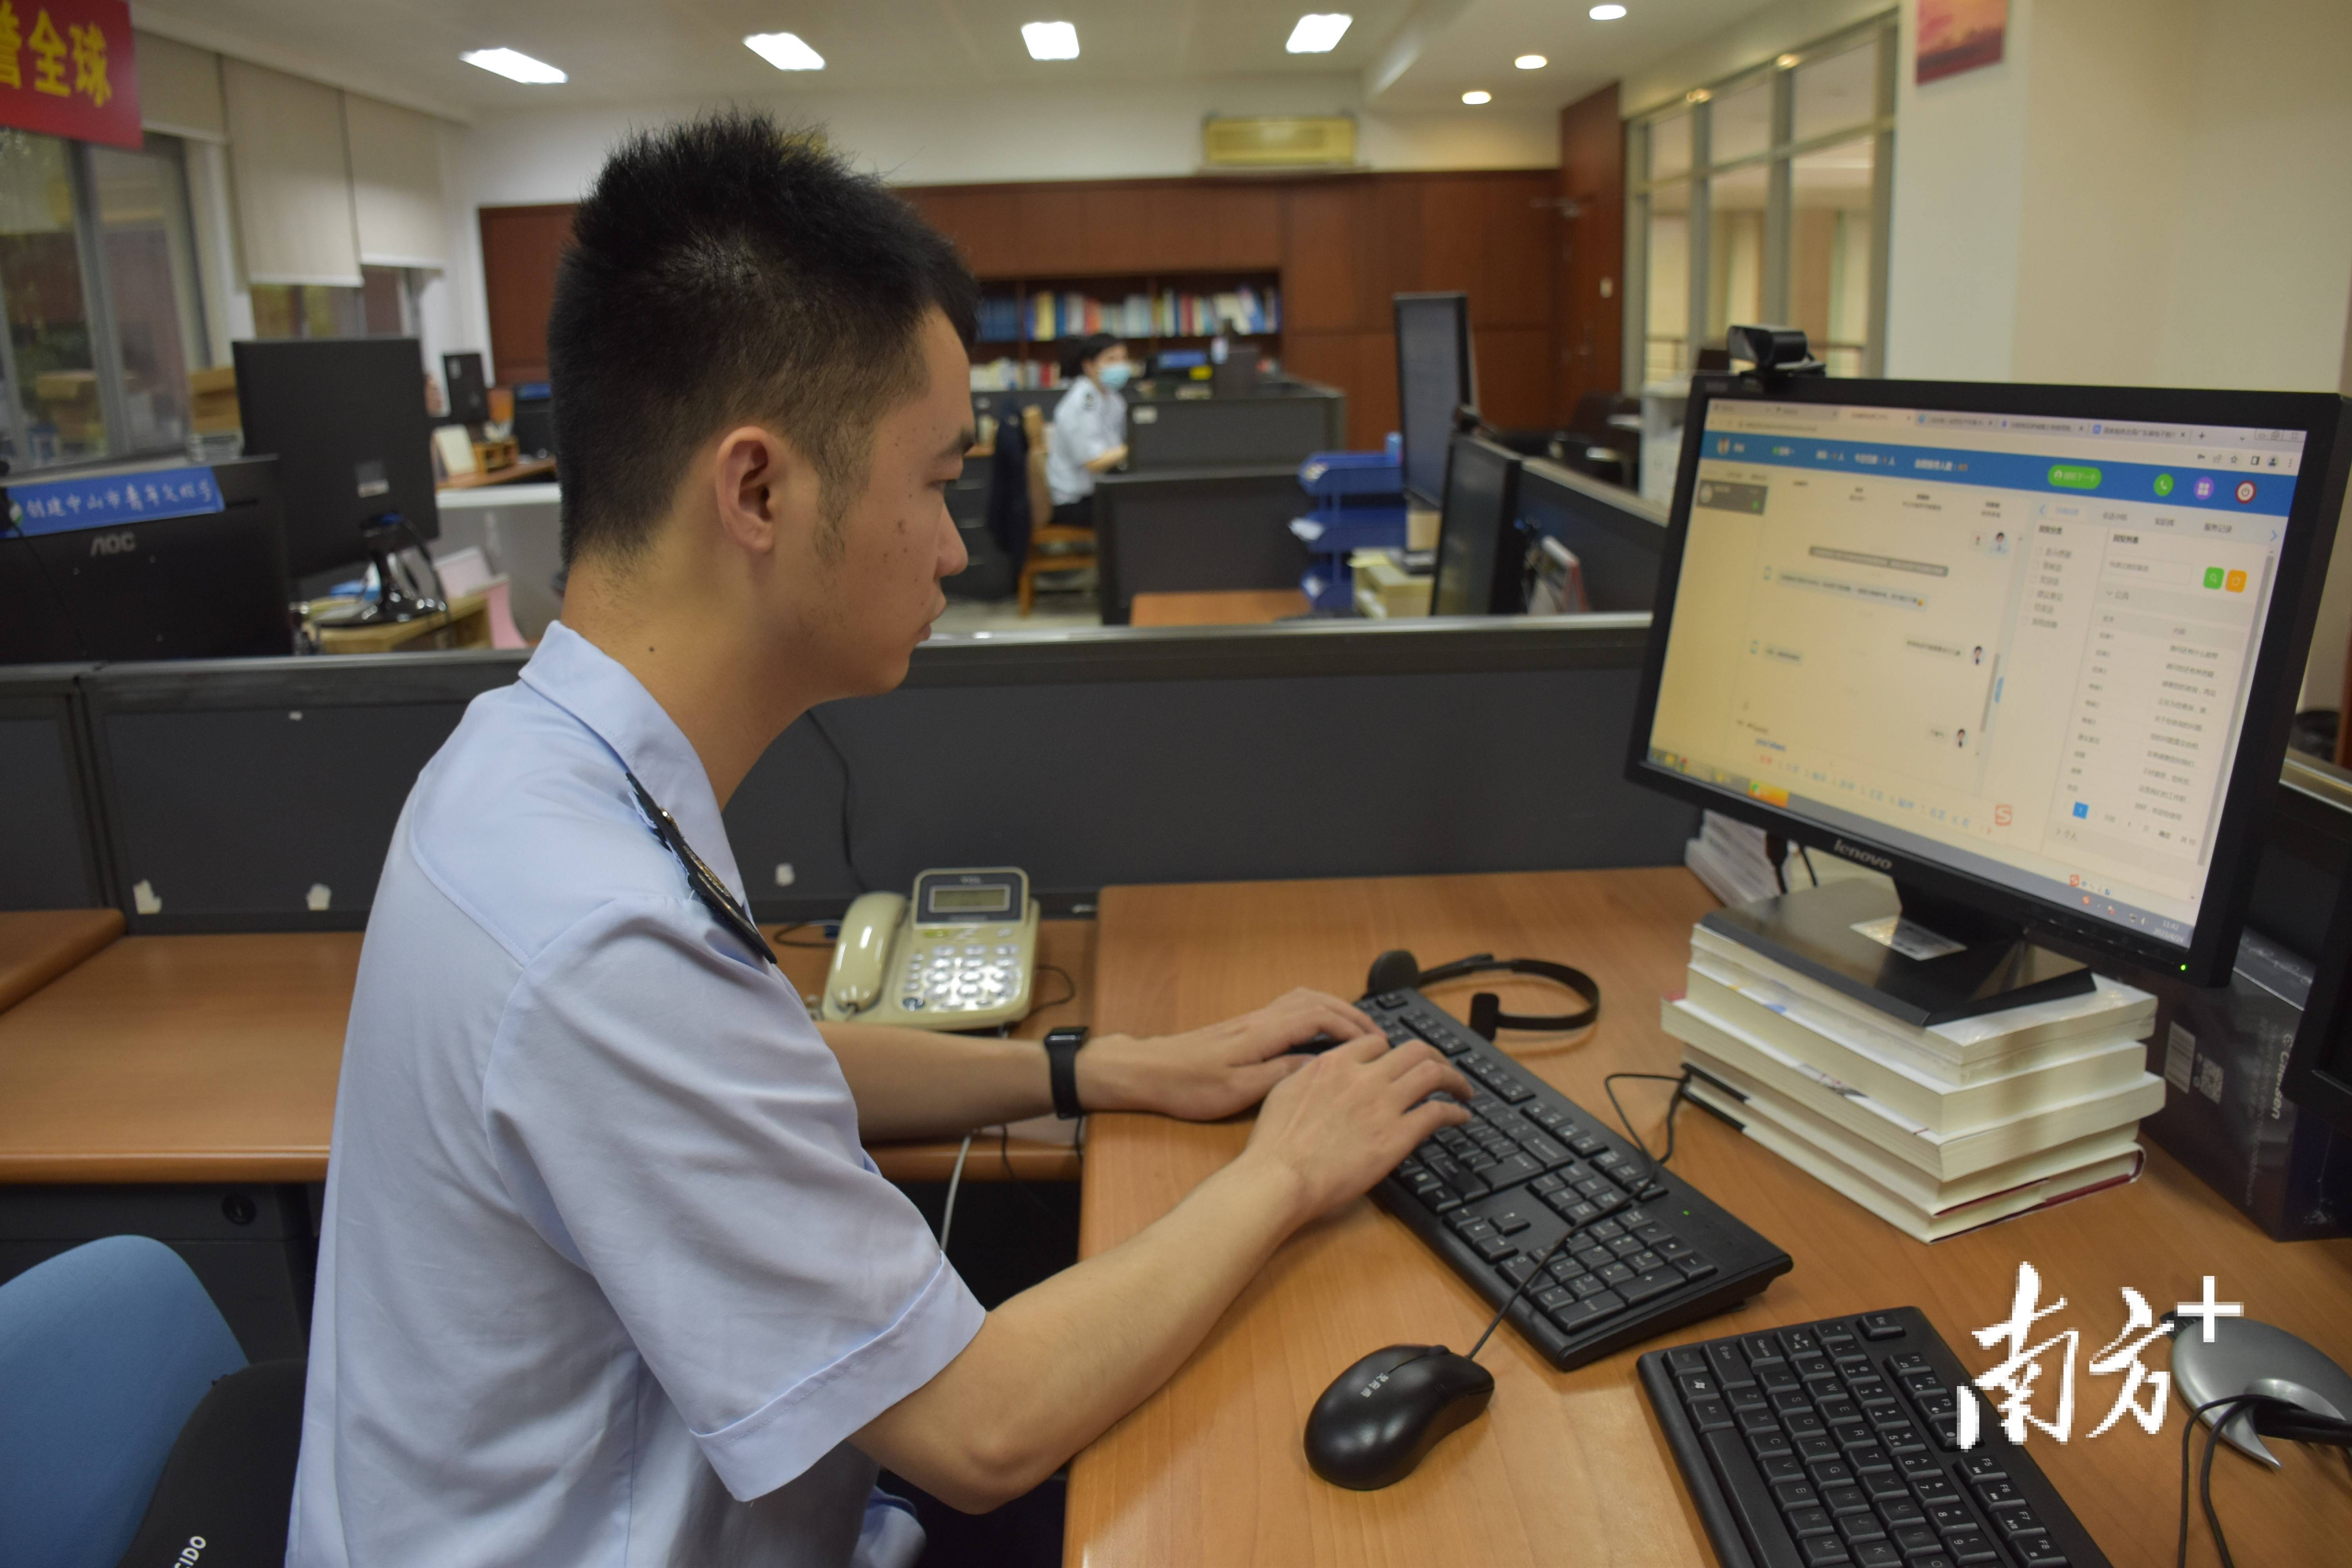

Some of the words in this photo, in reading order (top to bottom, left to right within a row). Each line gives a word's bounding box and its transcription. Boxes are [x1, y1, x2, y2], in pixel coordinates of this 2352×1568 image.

[1834, 838, 1892, 870] lenovo
[2000, 1484, 2010, 1492] F6
[2019, 1512, 2030, 1521] F7
[2038, 1540, 2050, 1549] F8
